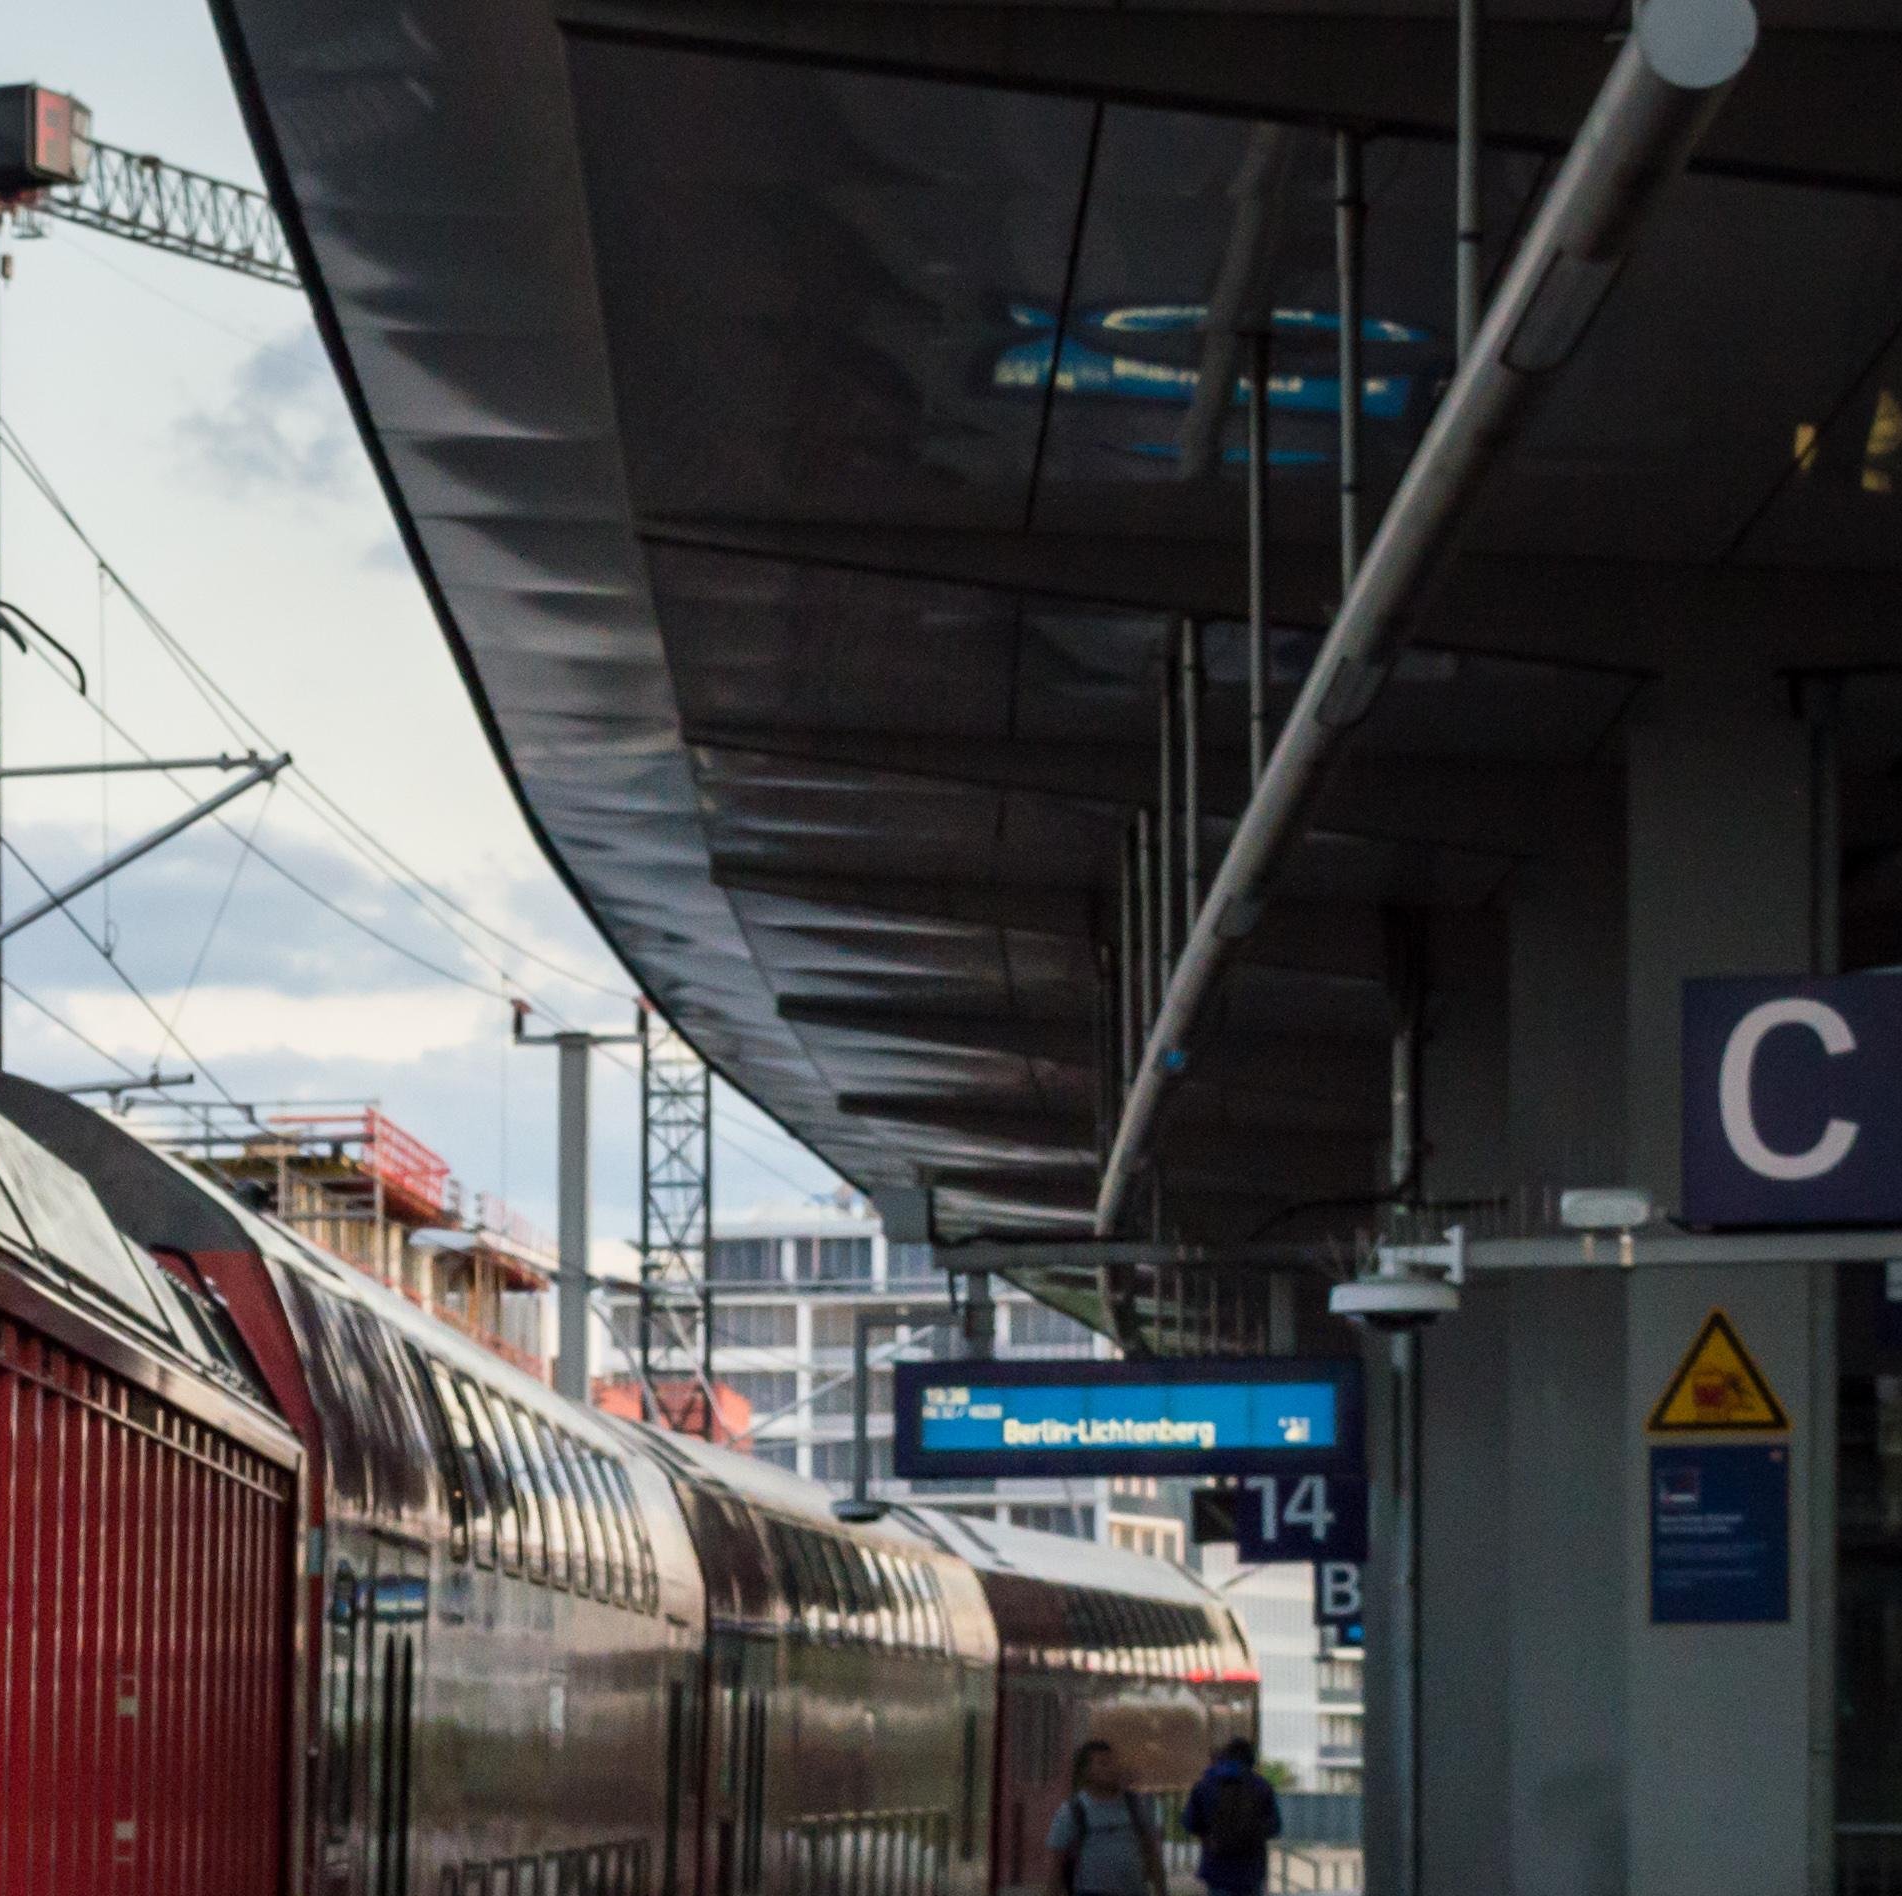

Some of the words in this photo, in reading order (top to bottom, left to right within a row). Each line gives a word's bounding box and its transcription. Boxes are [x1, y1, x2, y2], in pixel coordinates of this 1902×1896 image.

[1720, 998, 1860, 1181] C
[1003, 1417, 1216, 1450] Berlin-Lichtenberg
[1245, 1474, 1335, 1542] 14
[1322, 1562, 1360, 1616] B
